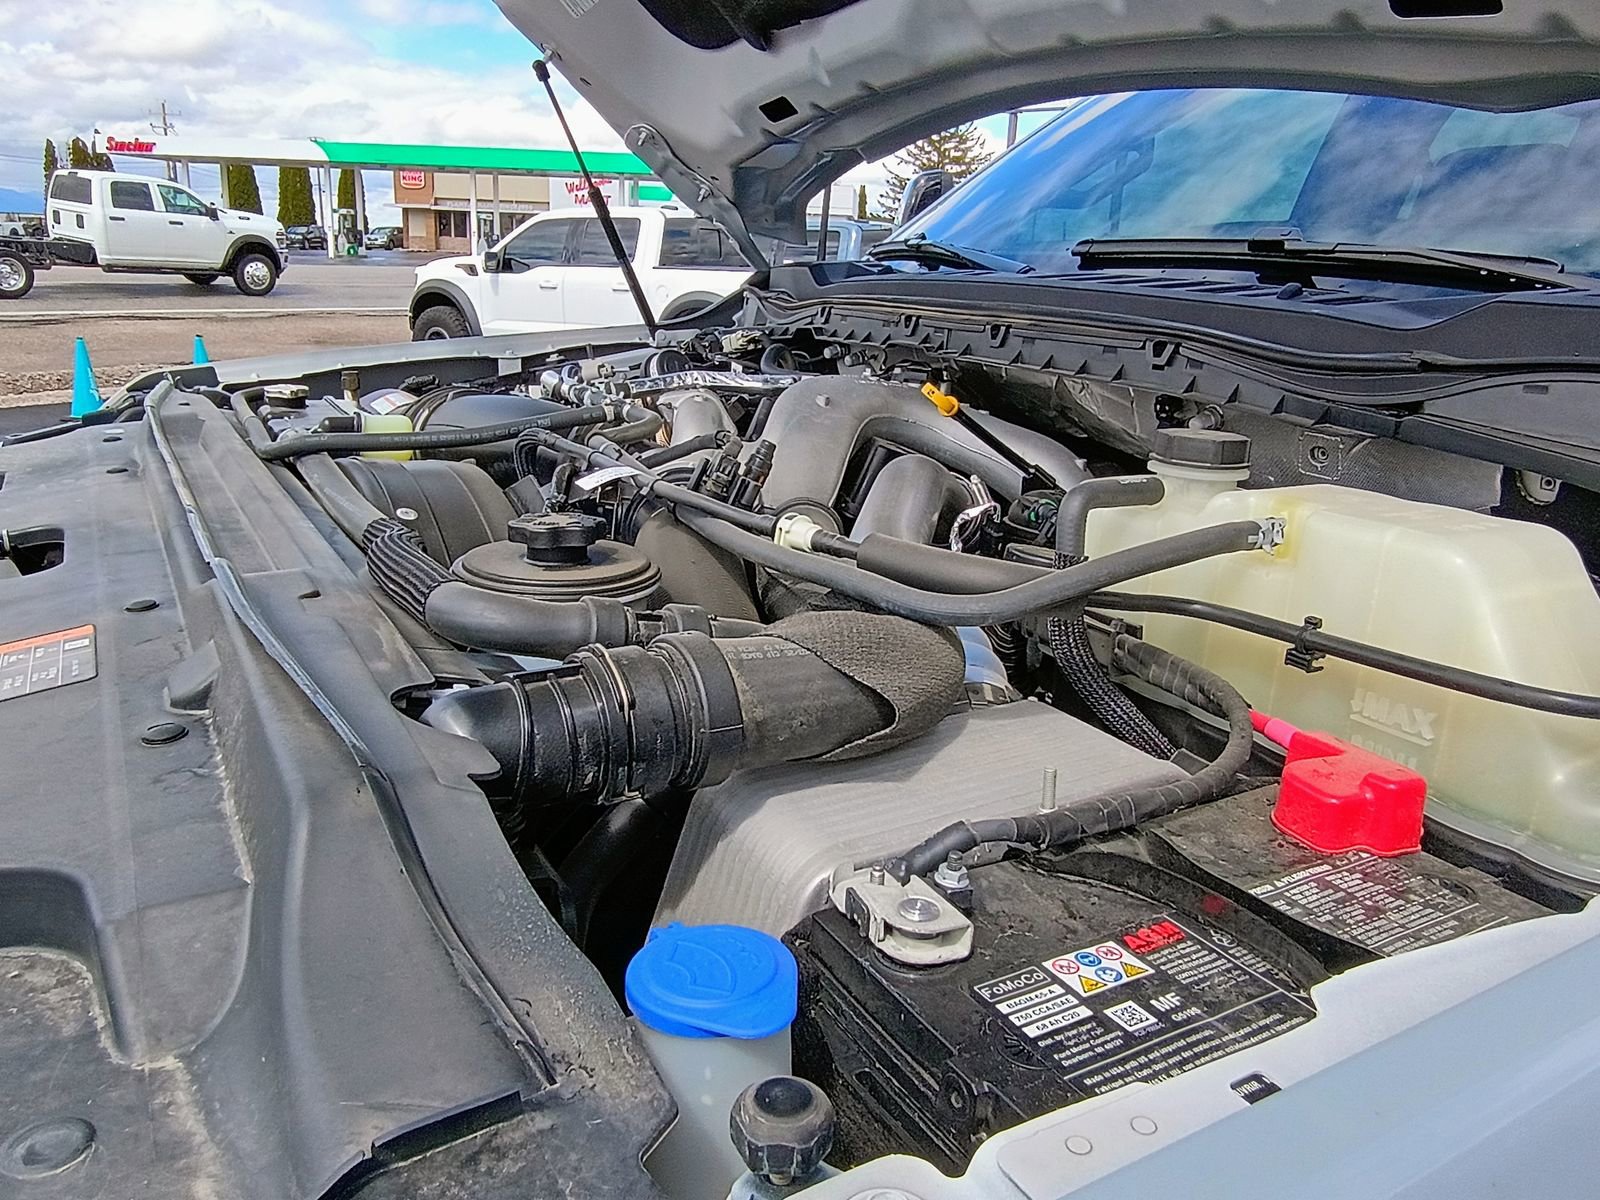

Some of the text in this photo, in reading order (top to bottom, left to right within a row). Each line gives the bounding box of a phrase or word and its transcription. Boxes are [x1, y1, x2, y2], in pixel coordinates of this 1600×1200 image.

[575, 194, 611, 206] MAT
[1361, 691, 1439, 740] MAX
[1123, 920, 1182, 951] AGM
[980, 972, 1044, 998] FoMoCo
[1151, 992, 1182, 1013] MF
[1014, 1012, 1032, 1023] 750
[1050, 1017, 1062, 1028] Ah
[1061, 1010, 1081, 1023] C20
[1053, 1050, 1071, 1060] Ford
[1084, 1075, 1104, 1085] Made
[1109, 1066, 1125, 1074] USA
